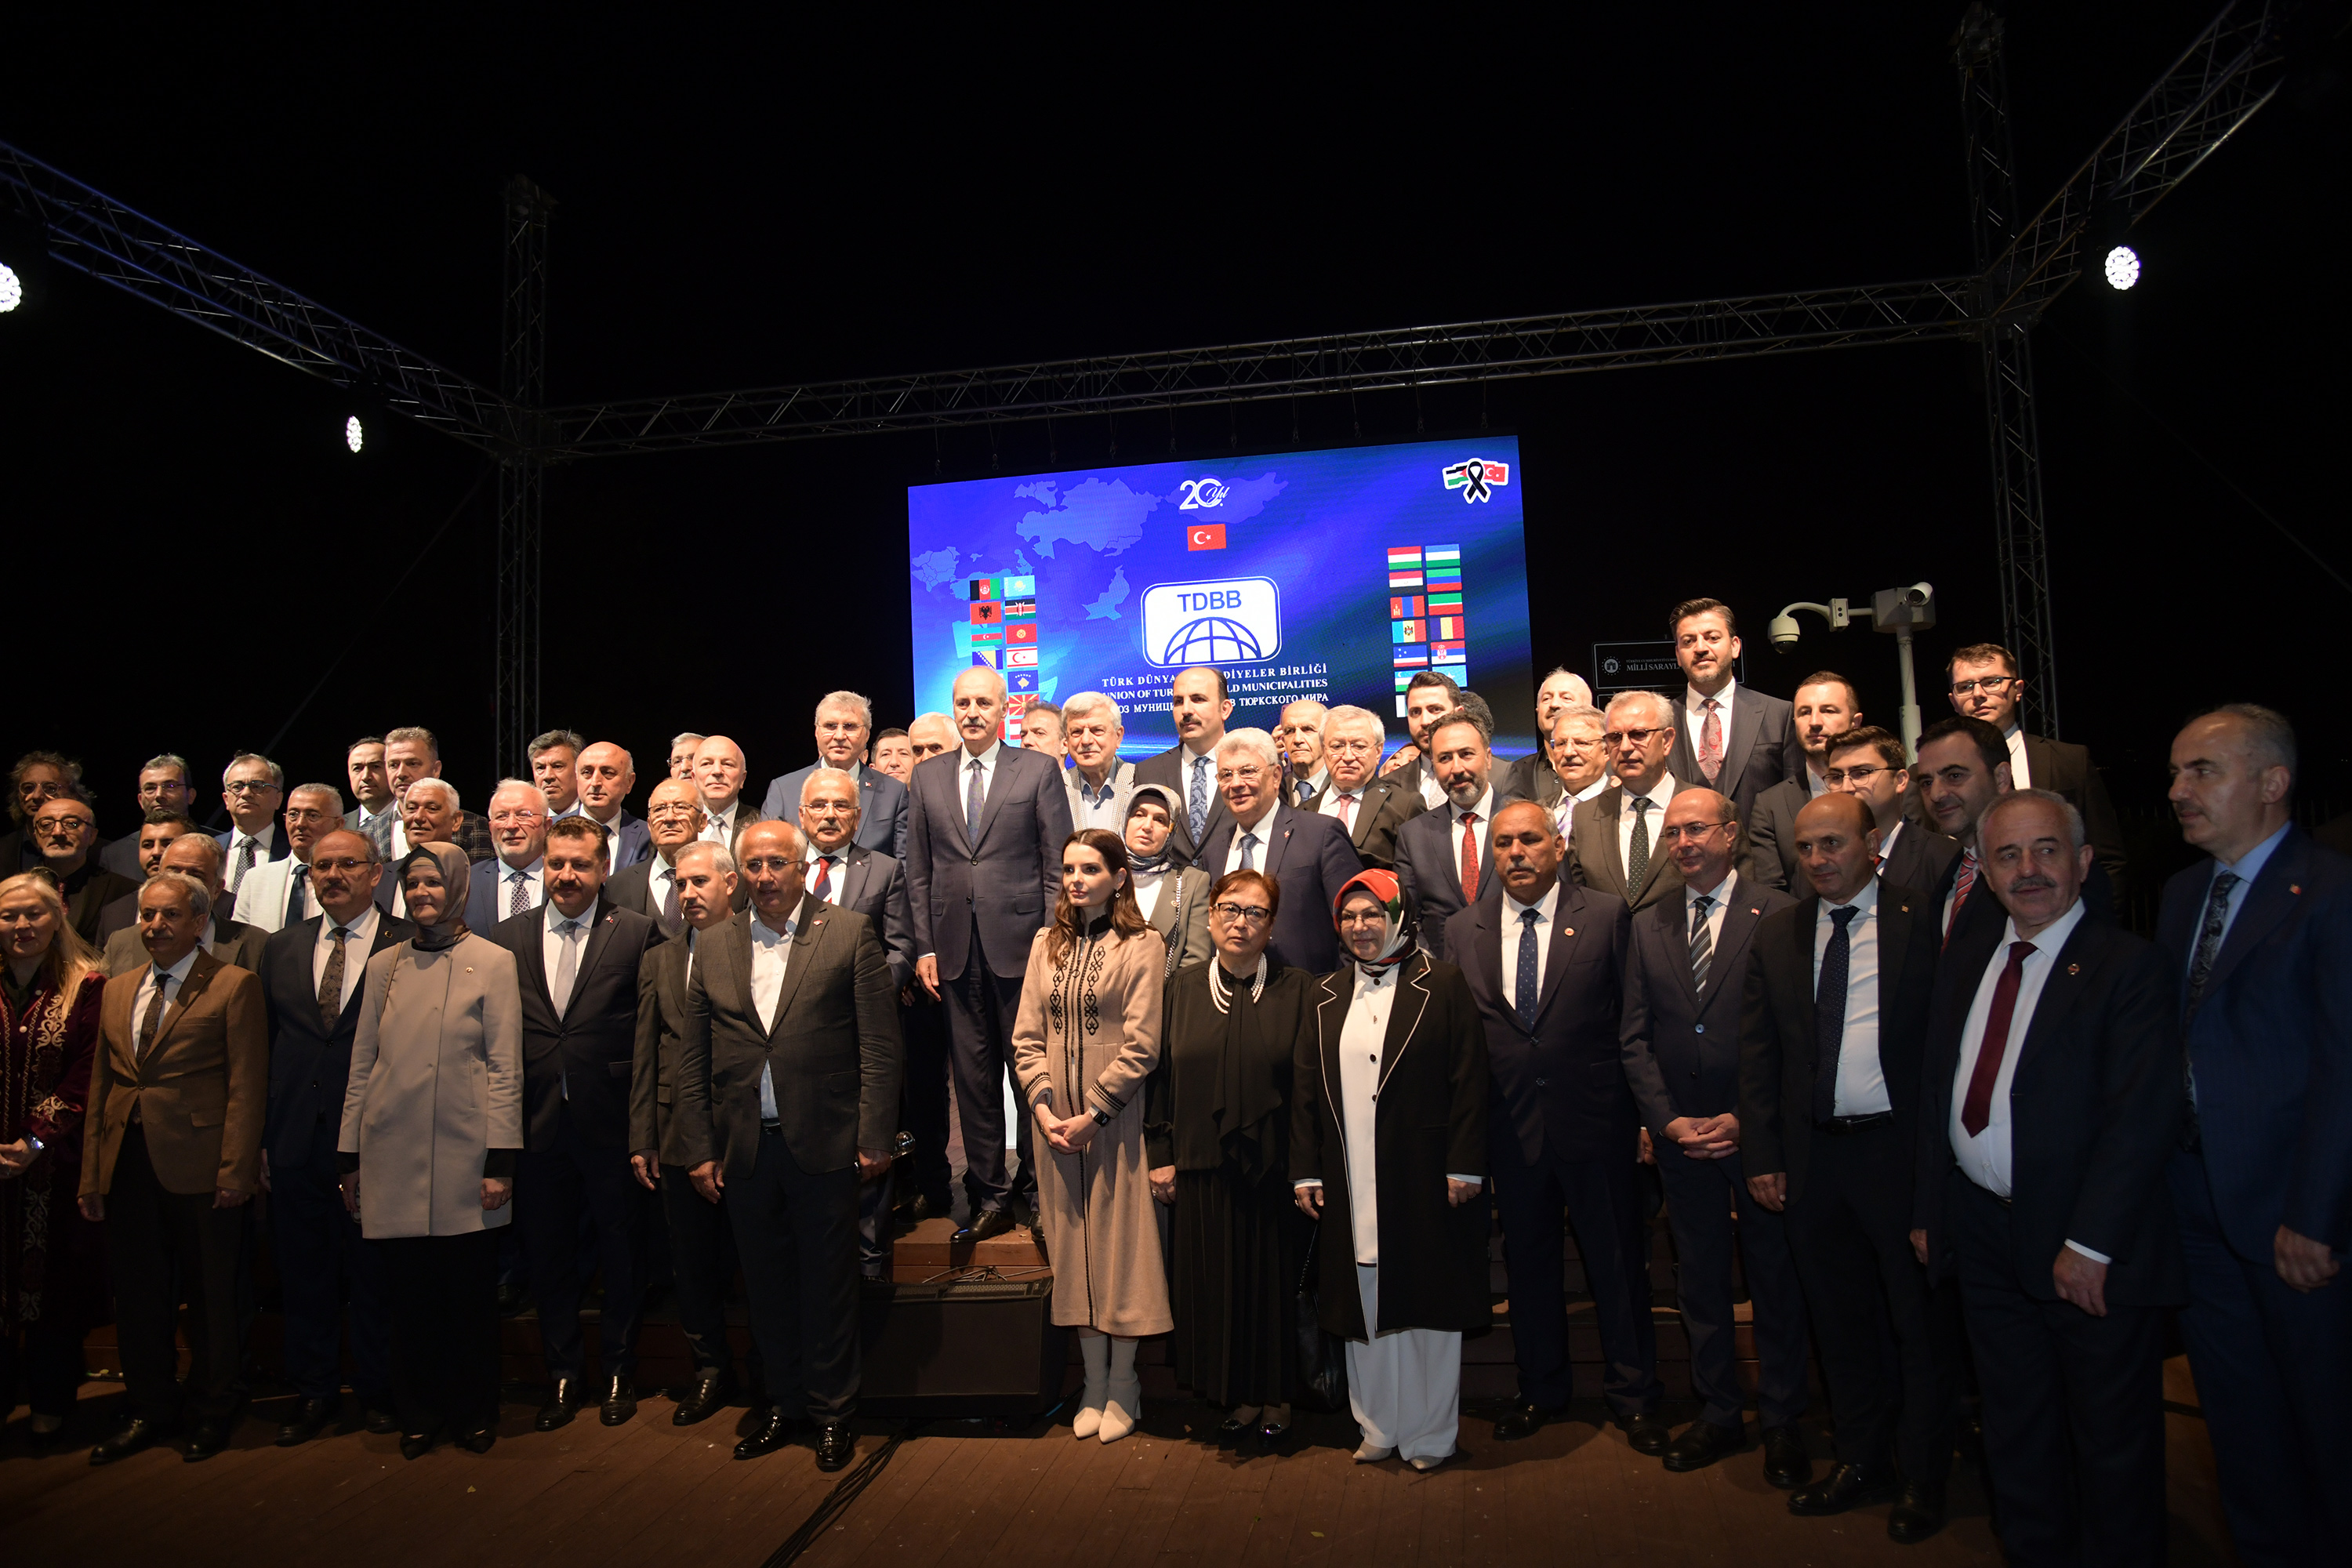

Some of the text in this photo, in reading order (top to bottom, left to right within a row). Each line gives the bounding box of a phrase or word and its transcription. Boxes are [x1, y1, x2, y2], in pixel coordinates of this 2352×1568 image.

[1177, 590, 1242, 612] TDBB
[1102, 662, 1327, 688] TÜRK DÜNYA DİYELER BİRLİĞİ
[1626, 662, 1648, 671] MİLLİ
[1137, 690, 1151, 699] OF
[1152, 688, 1174, 698] TUR
[1227, 684, 1240, 693] LD
[1242, 678, 1328, 692] MUNICIPALITIES
[1239, 695, 1298, 706] ТЮРКСКОГО
[1301, 692, 1329, 703] МИРА
